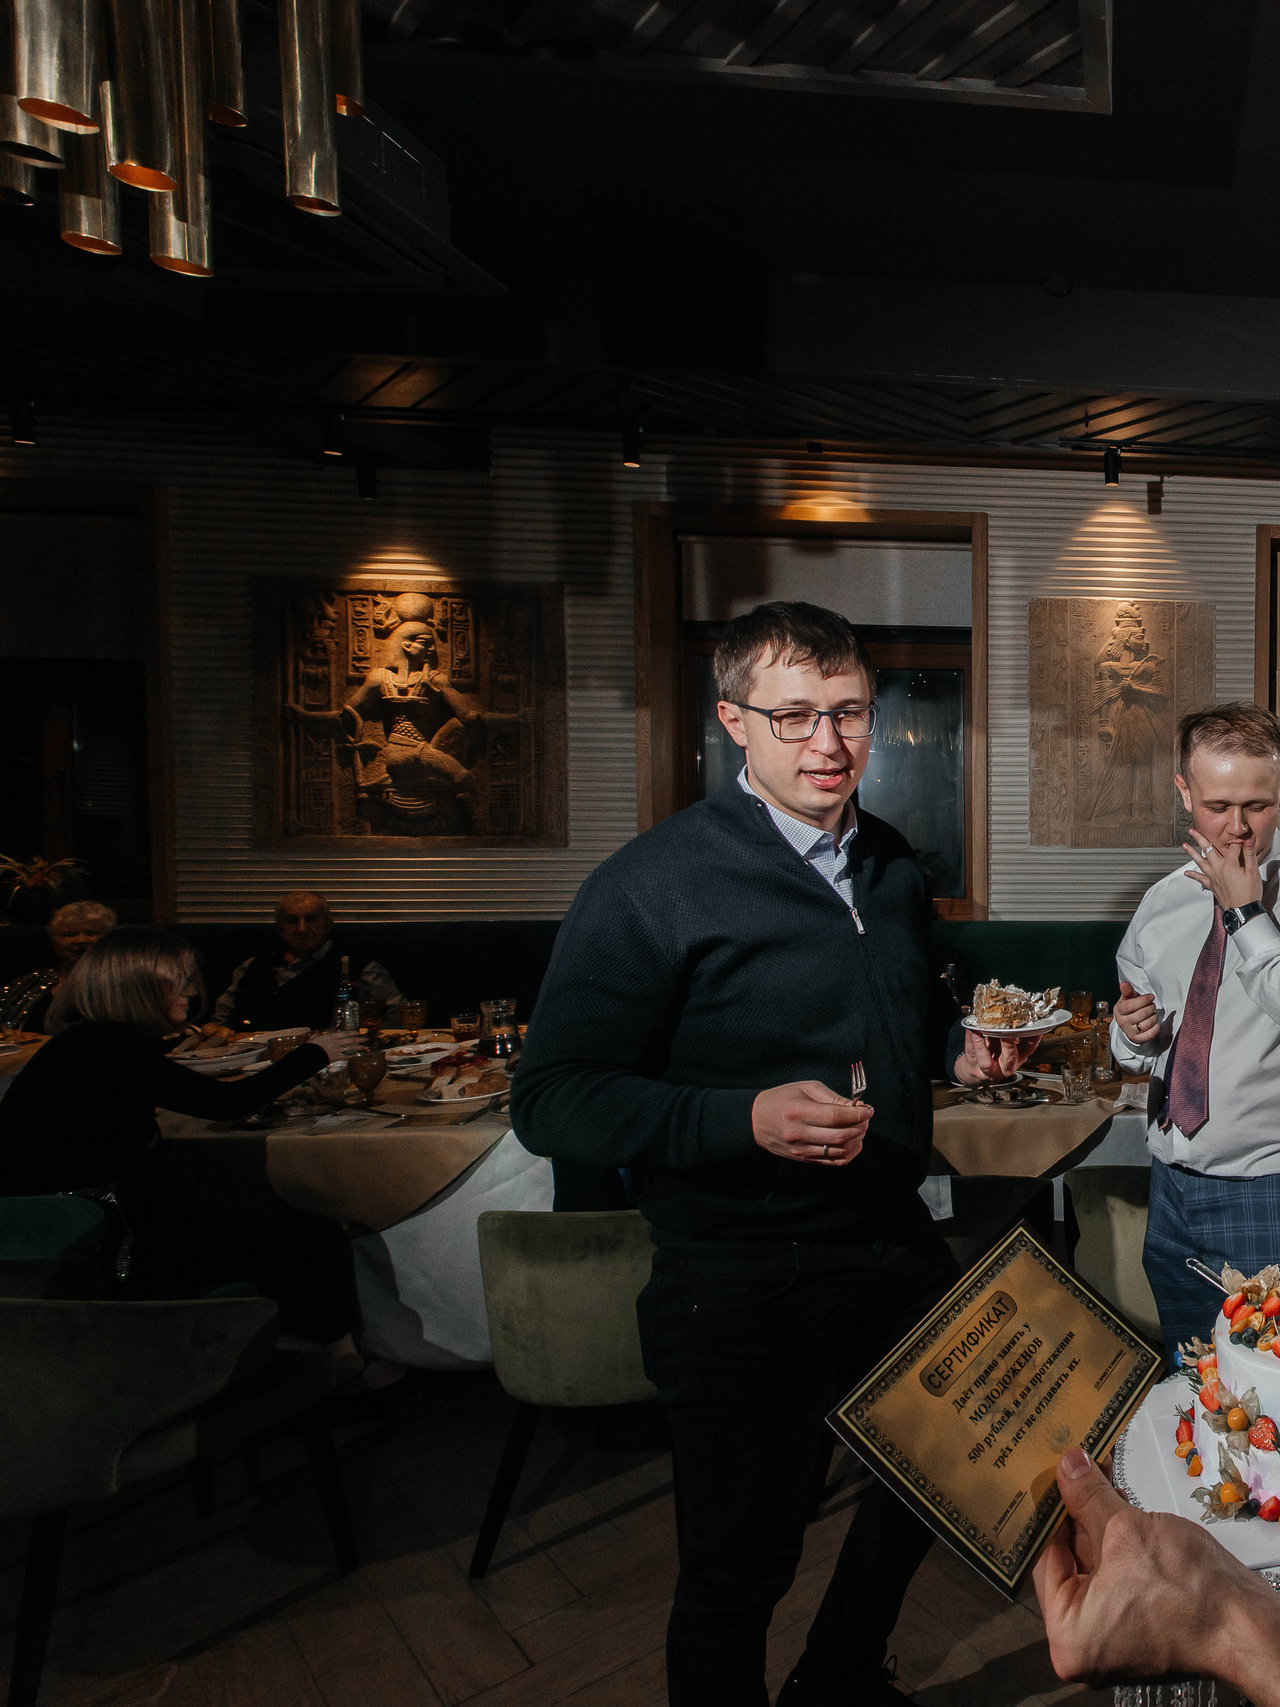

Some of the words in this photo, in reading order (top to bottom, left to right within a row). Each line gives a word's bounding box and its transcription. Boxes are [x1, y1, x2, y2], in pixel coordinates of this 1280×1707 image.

[928, 1298, 1009, 1389] СЕРТИФИКАТ
[952, 1387, 974, 1413] Даёт
[974, 1360, 998, 1389] право
[998, 1330, 1025, 1360] занять
[1023, 1322, 1031, 1333] у
[969, 1337, 1043, 1426] МОЛОДОЖЕНОВ
[968, 1443, 985, 1463] 500
[984, 1408, 1016, 1447] рублей,
[1013, 1398, 1021, 1408] и
[1019, 1385, 1032, 1399] на
[1031, 1331, 1075, 1387] протяжении
[993, 1445, 1013, 1469] трёх
[1012, 1427, 1026, 1447] лет
[1025, 1412, 1037, 1428] не
[1035, 1372, 1069, 1415] отдавать
[1067, 1359, 1081, 1372] их.
